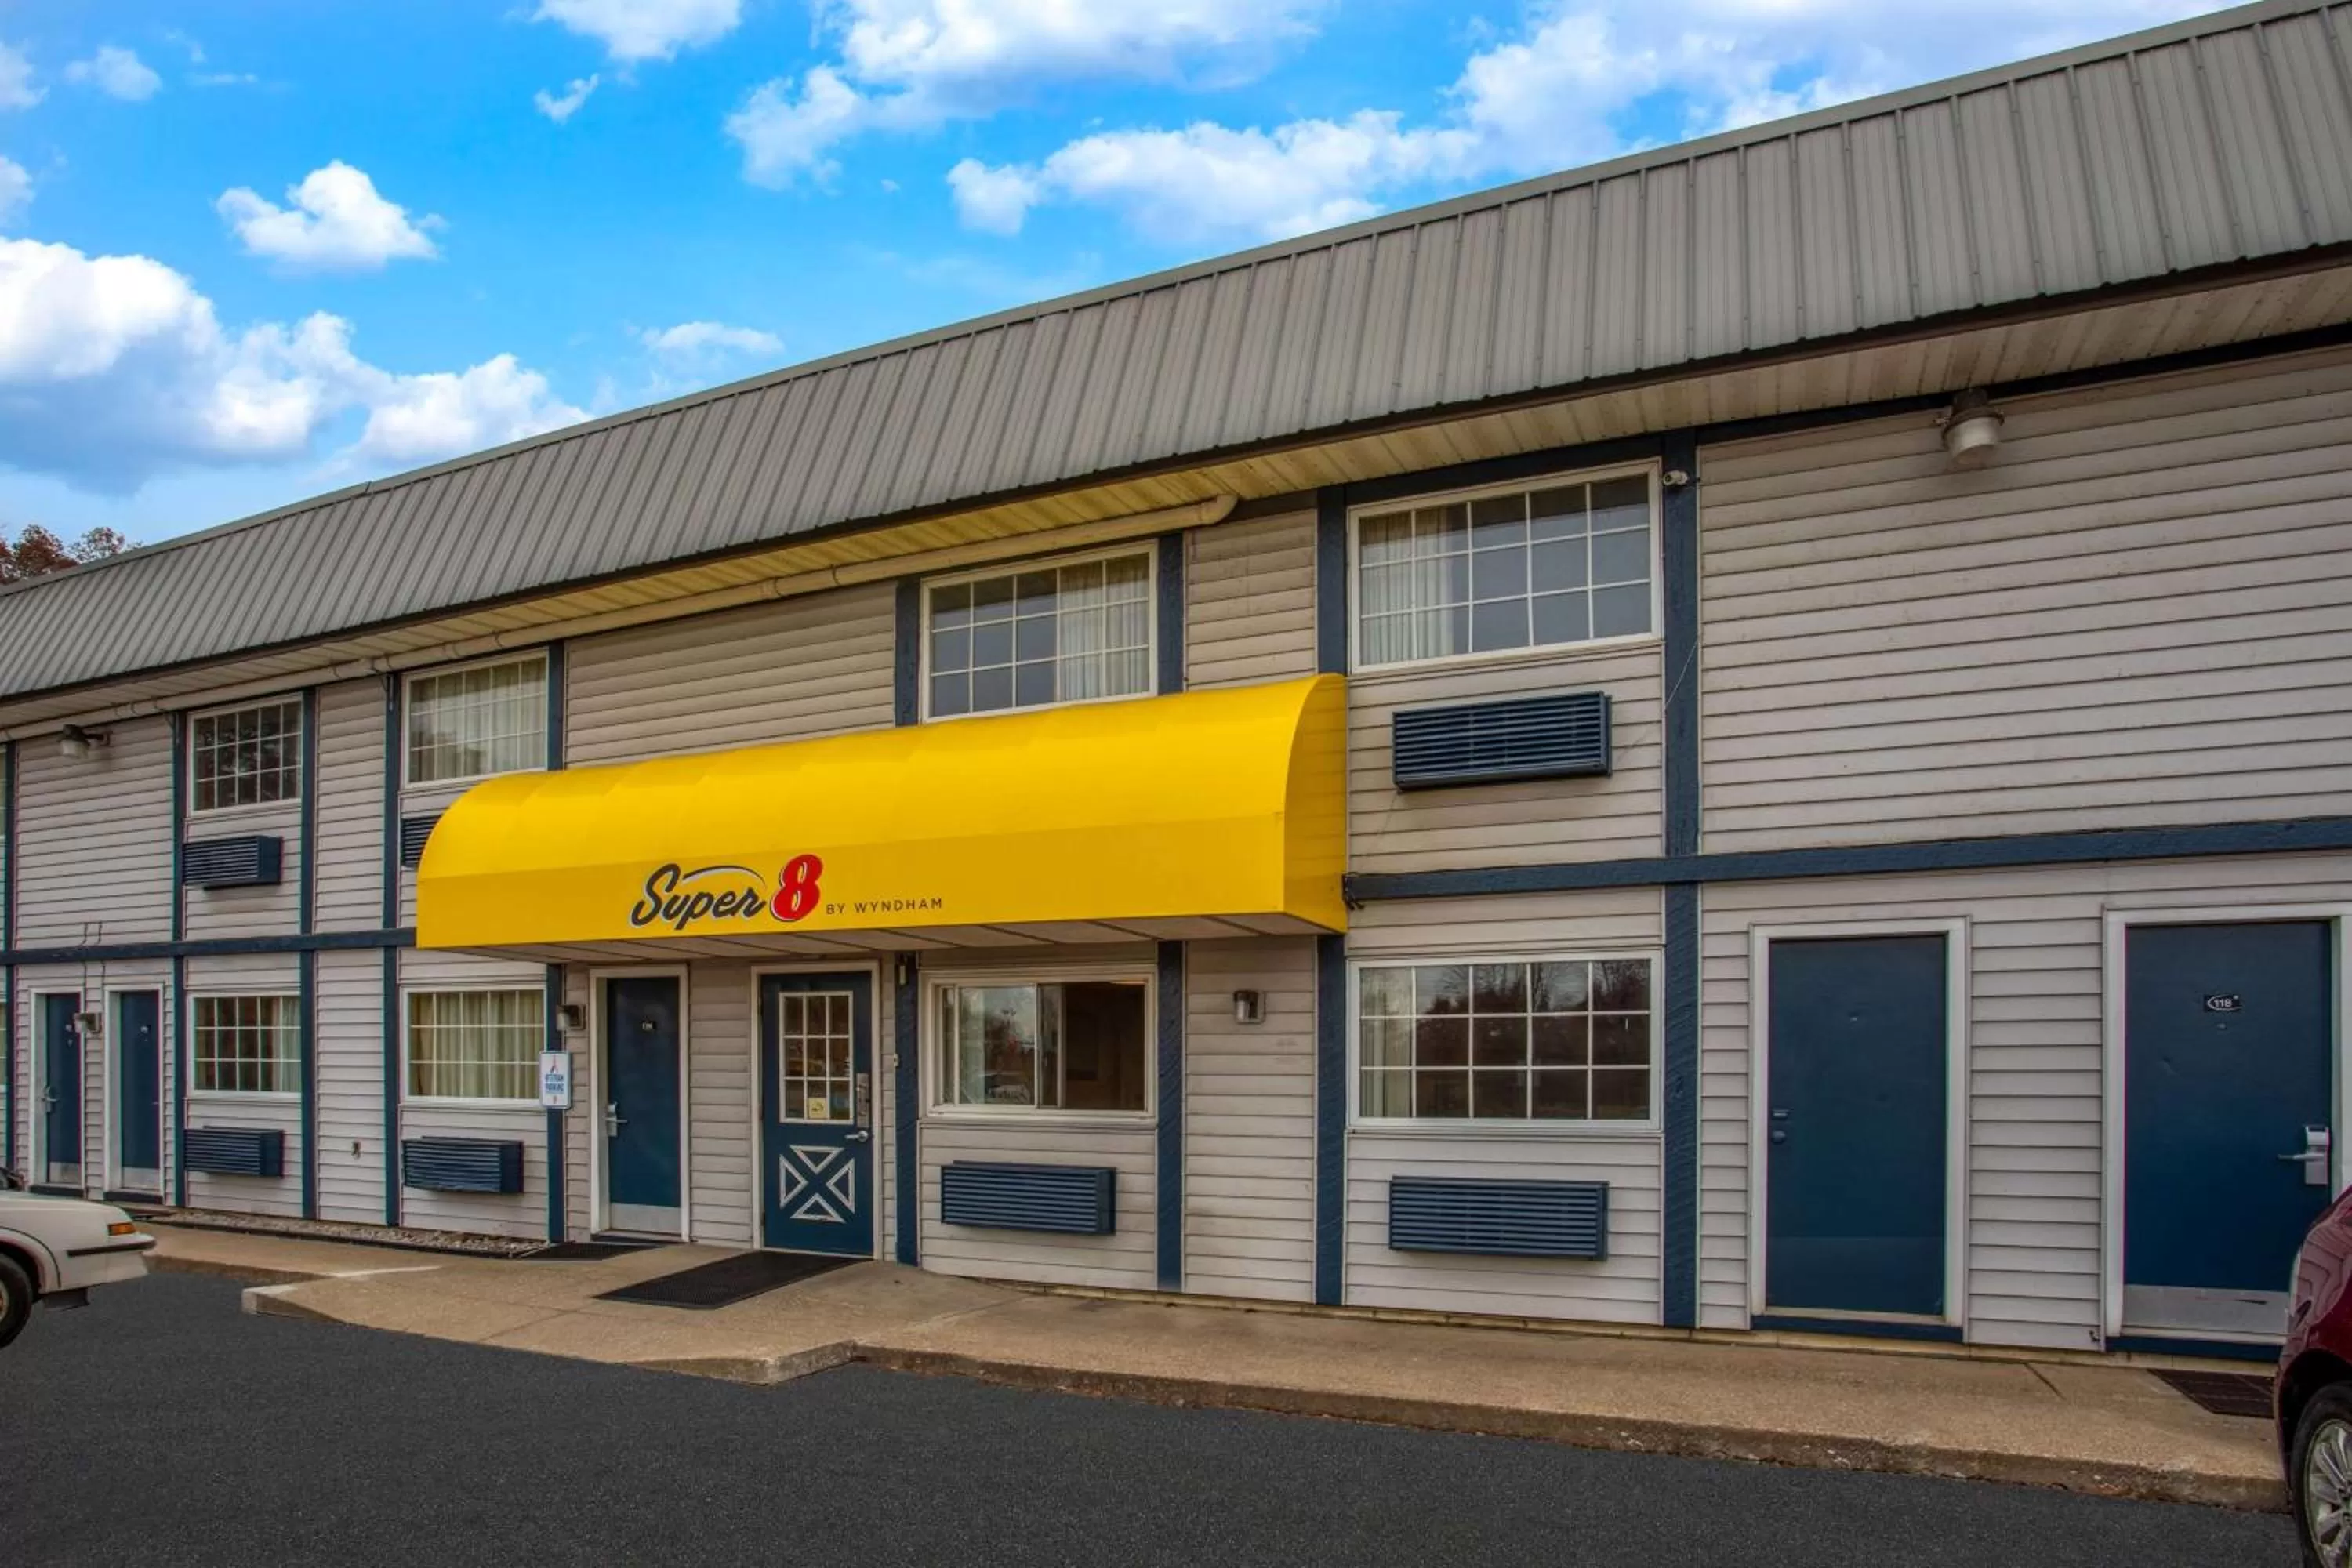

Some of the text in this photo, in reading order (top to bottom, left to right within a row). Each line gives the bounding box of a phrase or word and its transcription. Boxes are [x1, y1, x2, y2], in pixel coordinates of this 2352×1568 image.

[630, 854, 942, 931] Super 8 BY WYNDHAM
